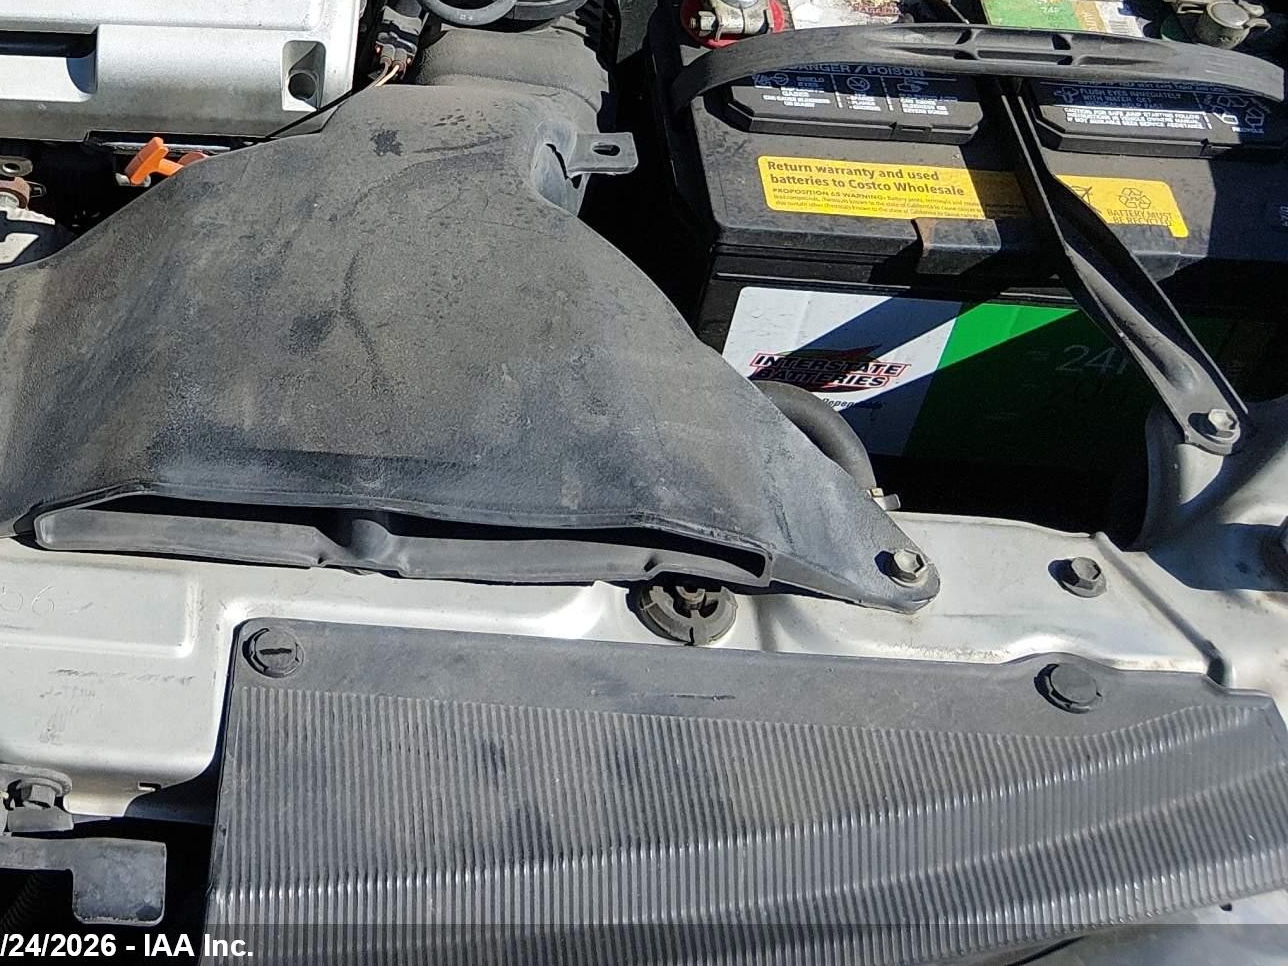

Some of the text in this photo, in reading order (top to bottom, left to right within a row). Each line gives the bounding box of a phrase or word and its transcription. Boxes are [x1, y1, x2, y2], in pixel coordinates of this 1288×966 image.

[867, 66, 927, 77] POISON
[767, 161, 939, 181] Return warranty and used
[770, 173, 965, 195] batteries to Costco Wholesale
[773, 188, 829, 196] PROPOSITION
[1107, 209, 1173, 220] BATTERY MUST
[753, 354, 905, 377] INTERSTATE
[757, 368, 890, 387] BATTERIES
